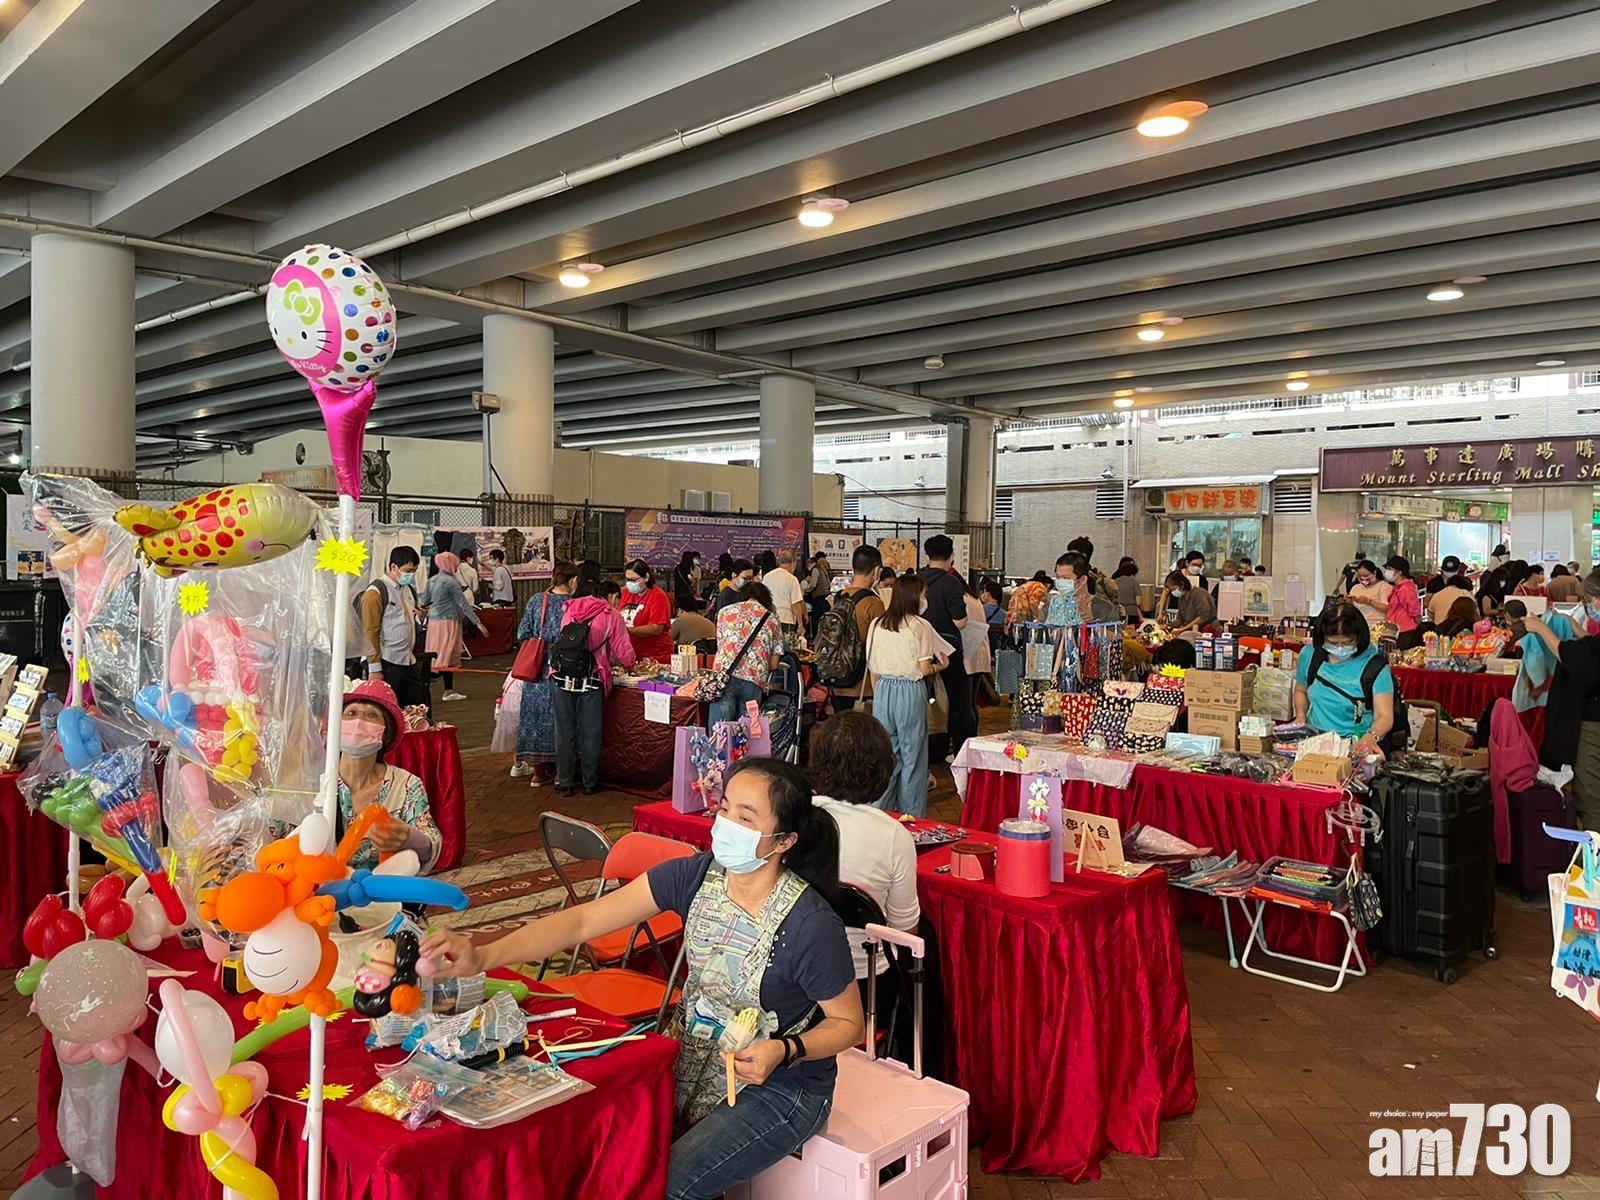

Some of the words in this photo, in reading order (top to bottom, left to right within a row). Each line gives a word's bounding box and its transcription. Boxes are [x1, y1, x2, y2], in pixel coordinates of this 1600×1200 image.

[1360, 472, 1416, 486] Mount
[1426, 467, 1502, 484] Sterling
[1514, 463, 1564, 480] Mall
